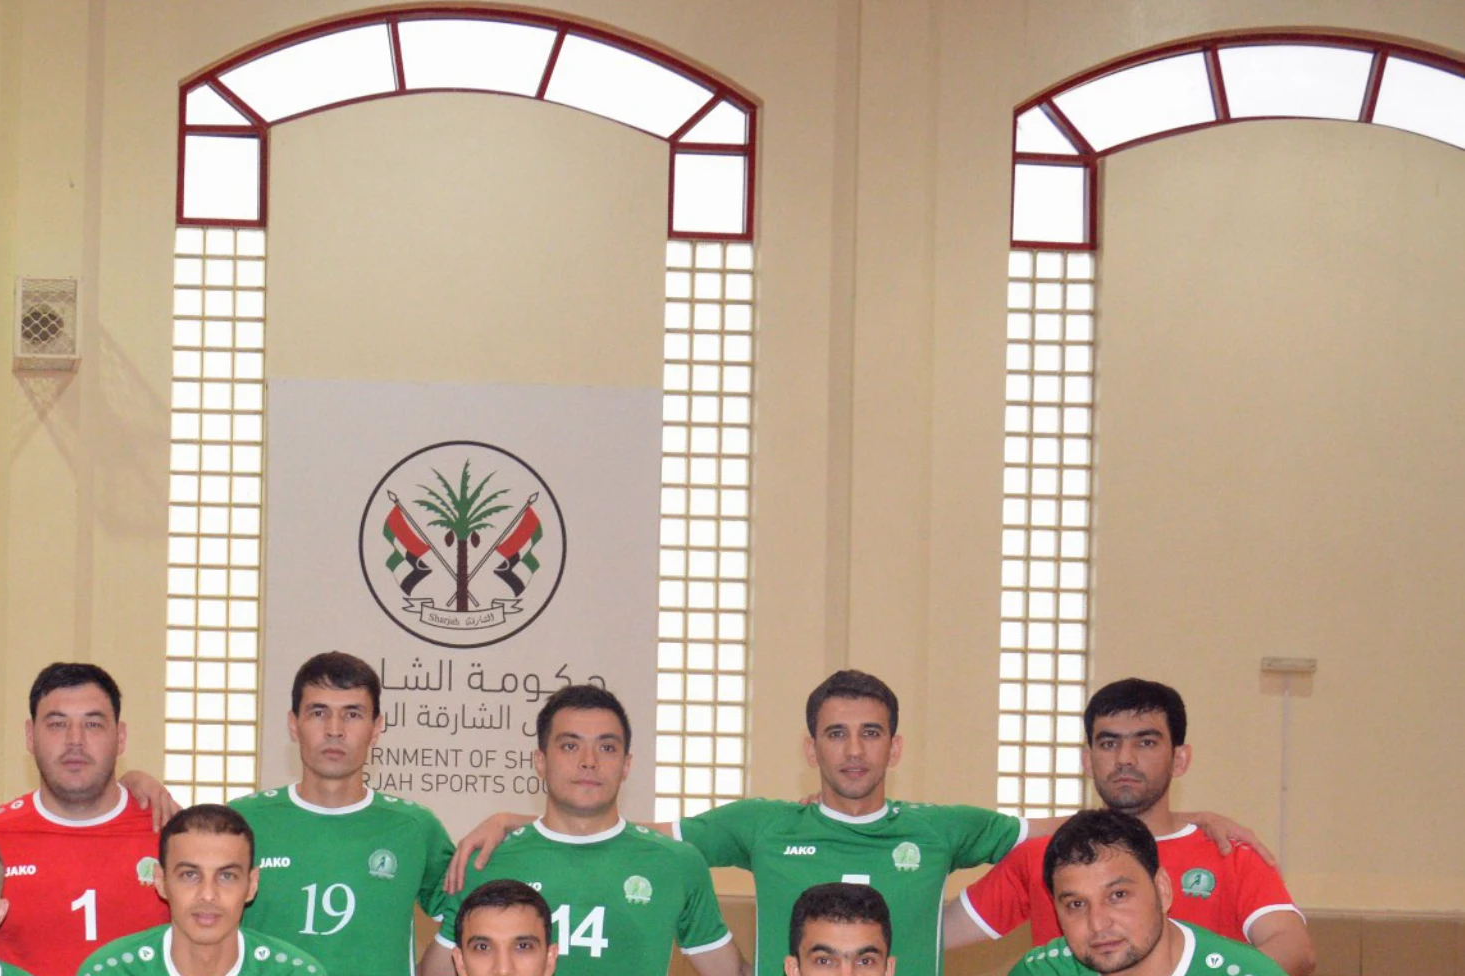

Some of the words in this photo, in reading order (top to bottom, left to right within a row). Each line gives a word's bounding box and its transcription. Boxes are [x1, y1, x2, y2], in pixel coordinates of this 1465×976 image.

[417, 703, 510, 735] الشارقة
[470, 750, 496, 768] OF
[421, 774, 505, 793] SPORTS
[784, 846, 816, 855] JAKO
[5, 865, 36, 877] JAKO
[259, 857, 291, 868] JAKO
[72, 890, 97, 940] 1
[299, 883, 355, 935] 19
[551, 904, 609, 958] 14
